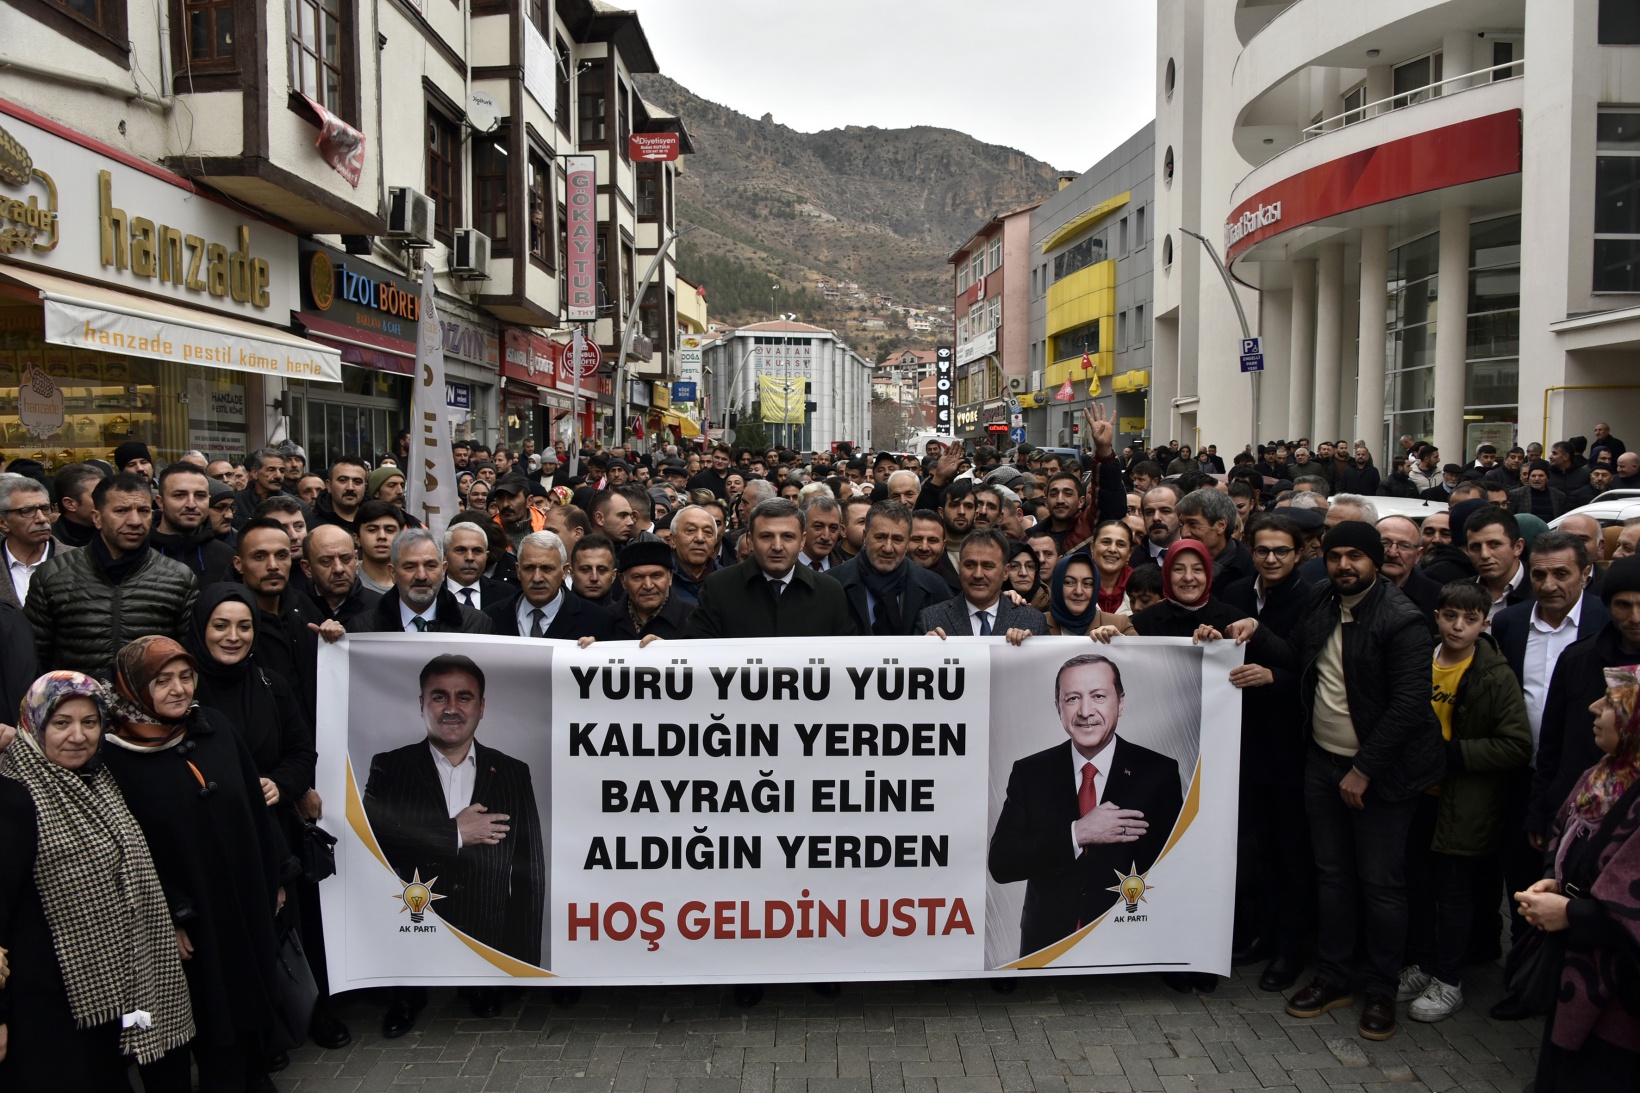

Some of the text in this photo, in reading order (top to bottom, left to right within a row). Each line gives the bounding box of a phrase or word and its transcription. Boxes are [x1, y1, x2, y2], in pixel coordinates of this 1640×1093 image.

[640, 136, 676, 146] Diyetisyen
[100, 169, 270, 308] hanzade
[571, 174, 591, 305] GÖKAY TUR
[1243, 200, 1281, 237] Bankası
[341, 262, 378, 309] İZOL
[84, 320, 322, 376] hanzade pestil köme herle
[387, 321, 402, 336] CAFE
[1244, 340, 1254, 353] P
[569, 659, 965, 701] YÜRÜ YÜRÜ YÜRÜ
[569, 713, 966, 757] KALDIĞIN YERDEN
[601, 770, 935, 813] BAYRAĞI ELİNE
[583, 826, 949, 870] ALDIĞIN YERDEN
[568, 889, 975, 952] HOŞ GELDİN USTA
